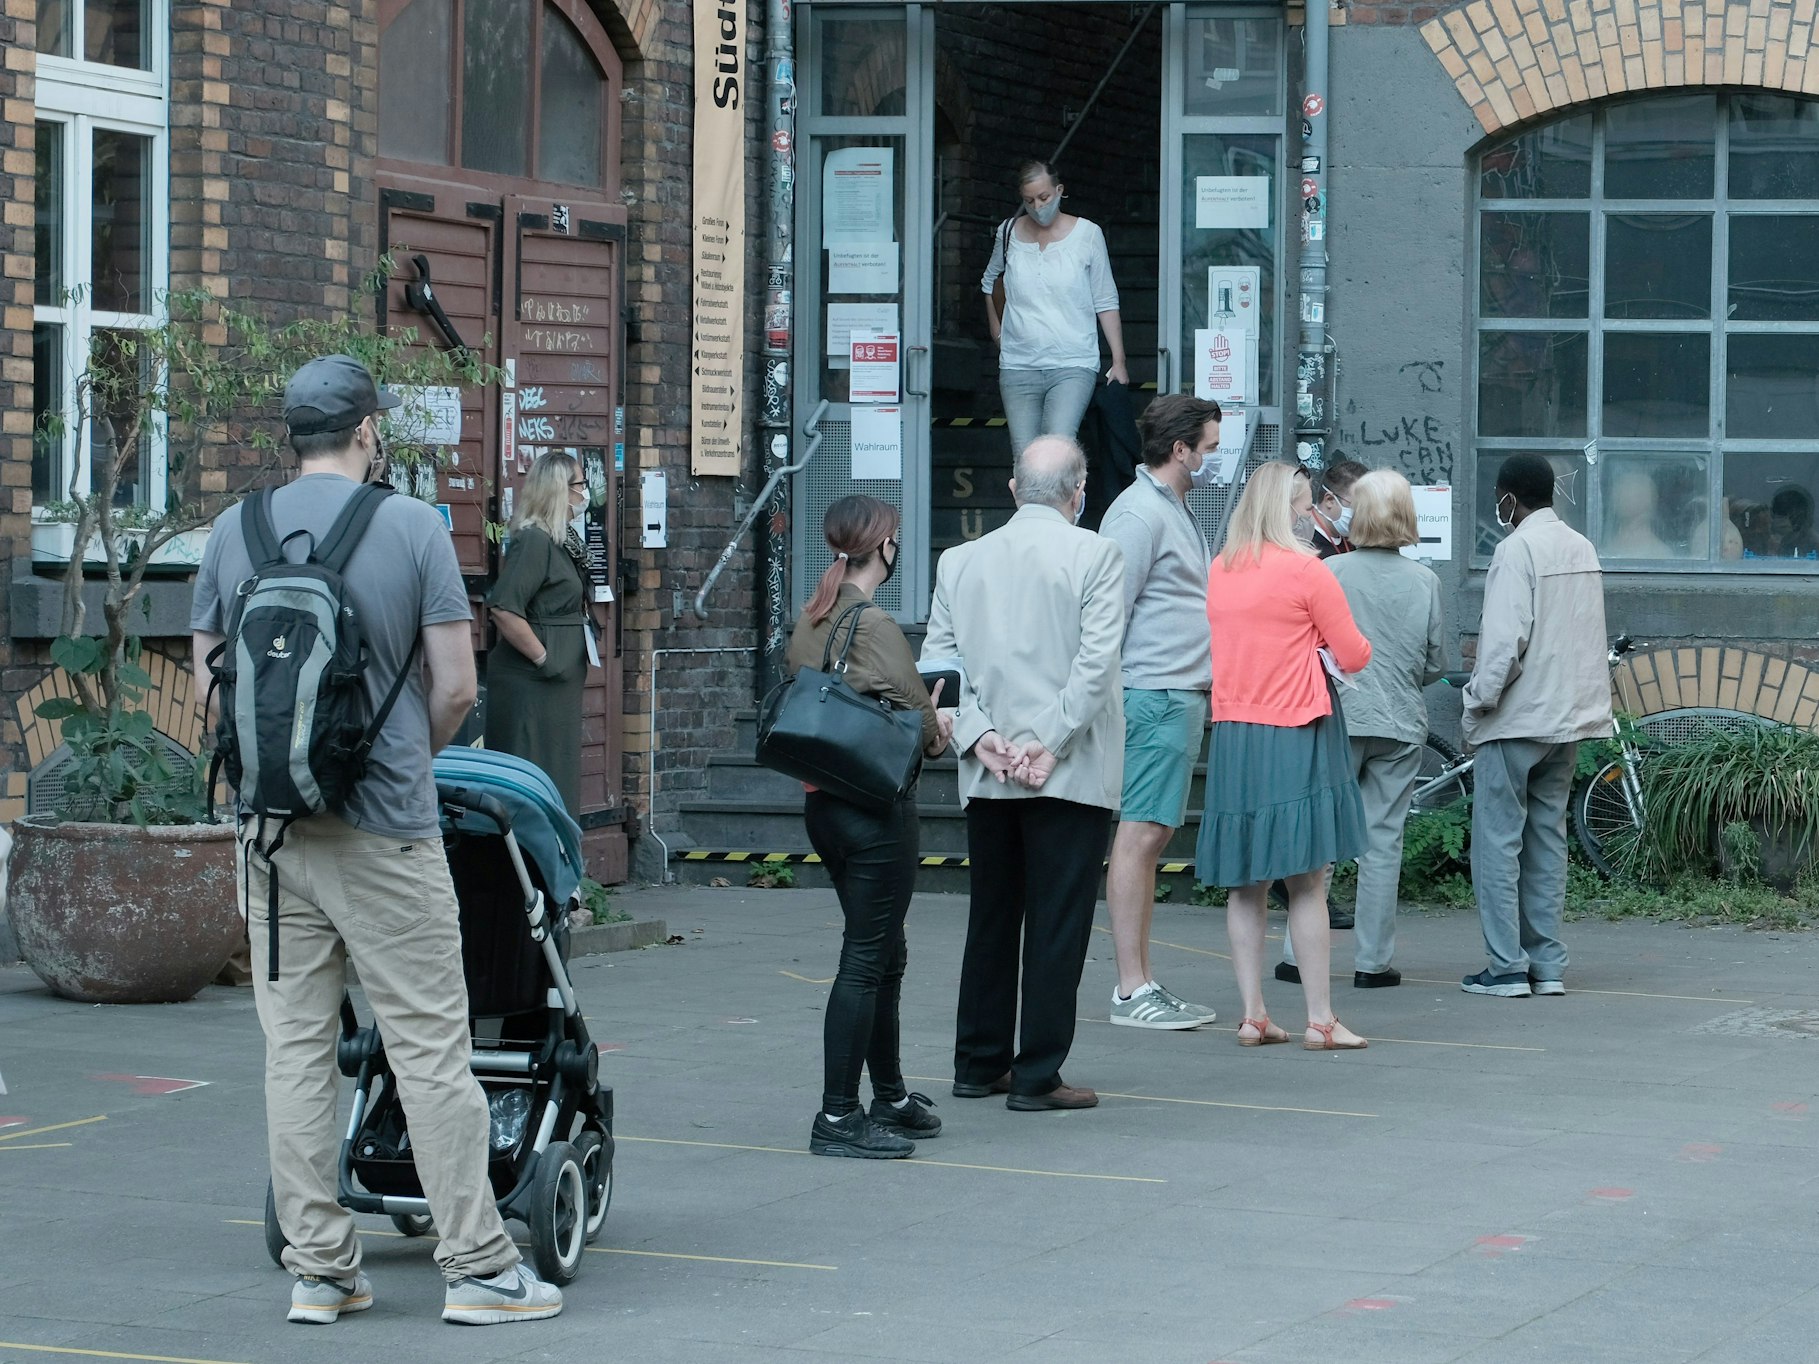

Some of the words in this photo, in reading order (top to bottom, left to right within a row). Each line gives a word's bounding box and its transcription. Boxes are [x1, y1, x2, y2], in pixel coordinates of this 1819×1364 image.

[854, 443, 898, 451] Wahlraum
[1219, 447, 1243, 455] raum
[952, 467, 974, 498] S
[1416, 514, 1449, 523] hlraum
[961, 508, 983, 540] Ü
[266, 650, 292, 659] deuter
